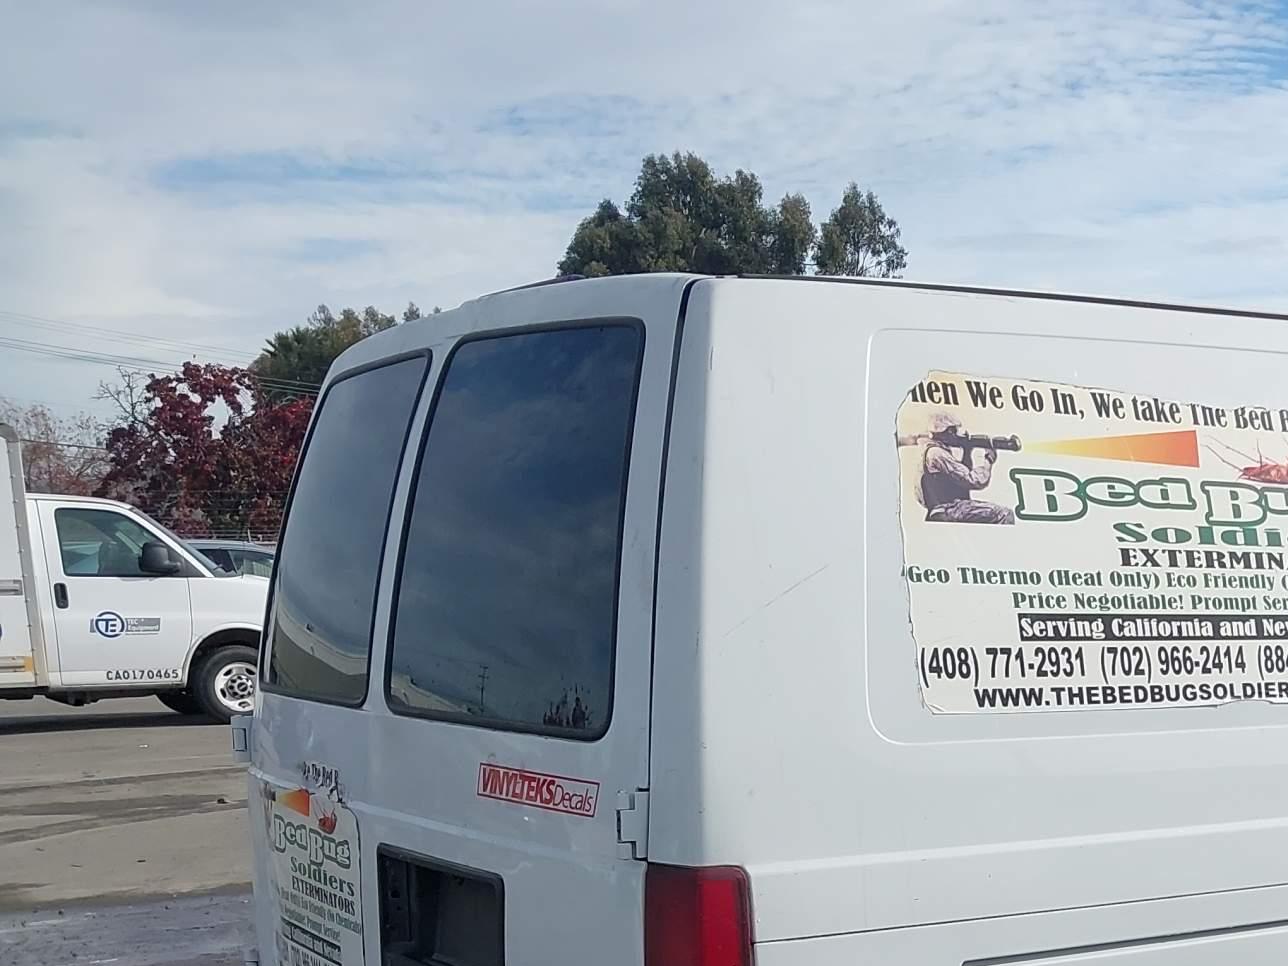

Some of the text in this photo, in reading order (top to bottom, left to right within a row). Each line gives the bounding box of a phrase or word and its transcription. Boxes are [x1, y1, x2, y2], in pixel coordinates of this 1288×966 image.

[965, 380, 1004, 409] We
[1011, 385, 1044, 412] Go
[1050, 388, 1084, 419] In,
[1090, 391, 1126, 420] We
[1131, 395, 1182, 425] take
[1188, 404, 1228, 429] The
[1235, 407, 1275, 432] Bed
[1009, 468, 1197, 522] Bed
[908, 565, 950, 585] Geo
[957, 566, 1042, 585] Thermo
[1048, 569, 1102, 588] (Heat
[1109, 570, 1160, 590] Only)
[1166, 572, 1197, 588] Eco
[1204, 573, 1276, 591] Friendly
[1011, 592, 1067, 609] Price
[1074, 593, 1184, 611] Negotiable!
[1191, 595, 1257, 612] Prompt
[1020, 617, 1105, 639] Serving
[1111, 616, 1213, 638] California
[1219, 618, 1257, 637] and
[106, 669, 179, 681] CA0170465
[921, 647, 979, 688] (408)
[985, 647, 1086, 678] 771-2931
[1101, 646, 1151, 685] (702)
[1158, 645, 1247, 675] 966-2414
[273, 813, 351, 870] Bed Bug
[290, 856, 355, 897] Soldiers
[292, 876, 356, 917] EXTERMINATORS
